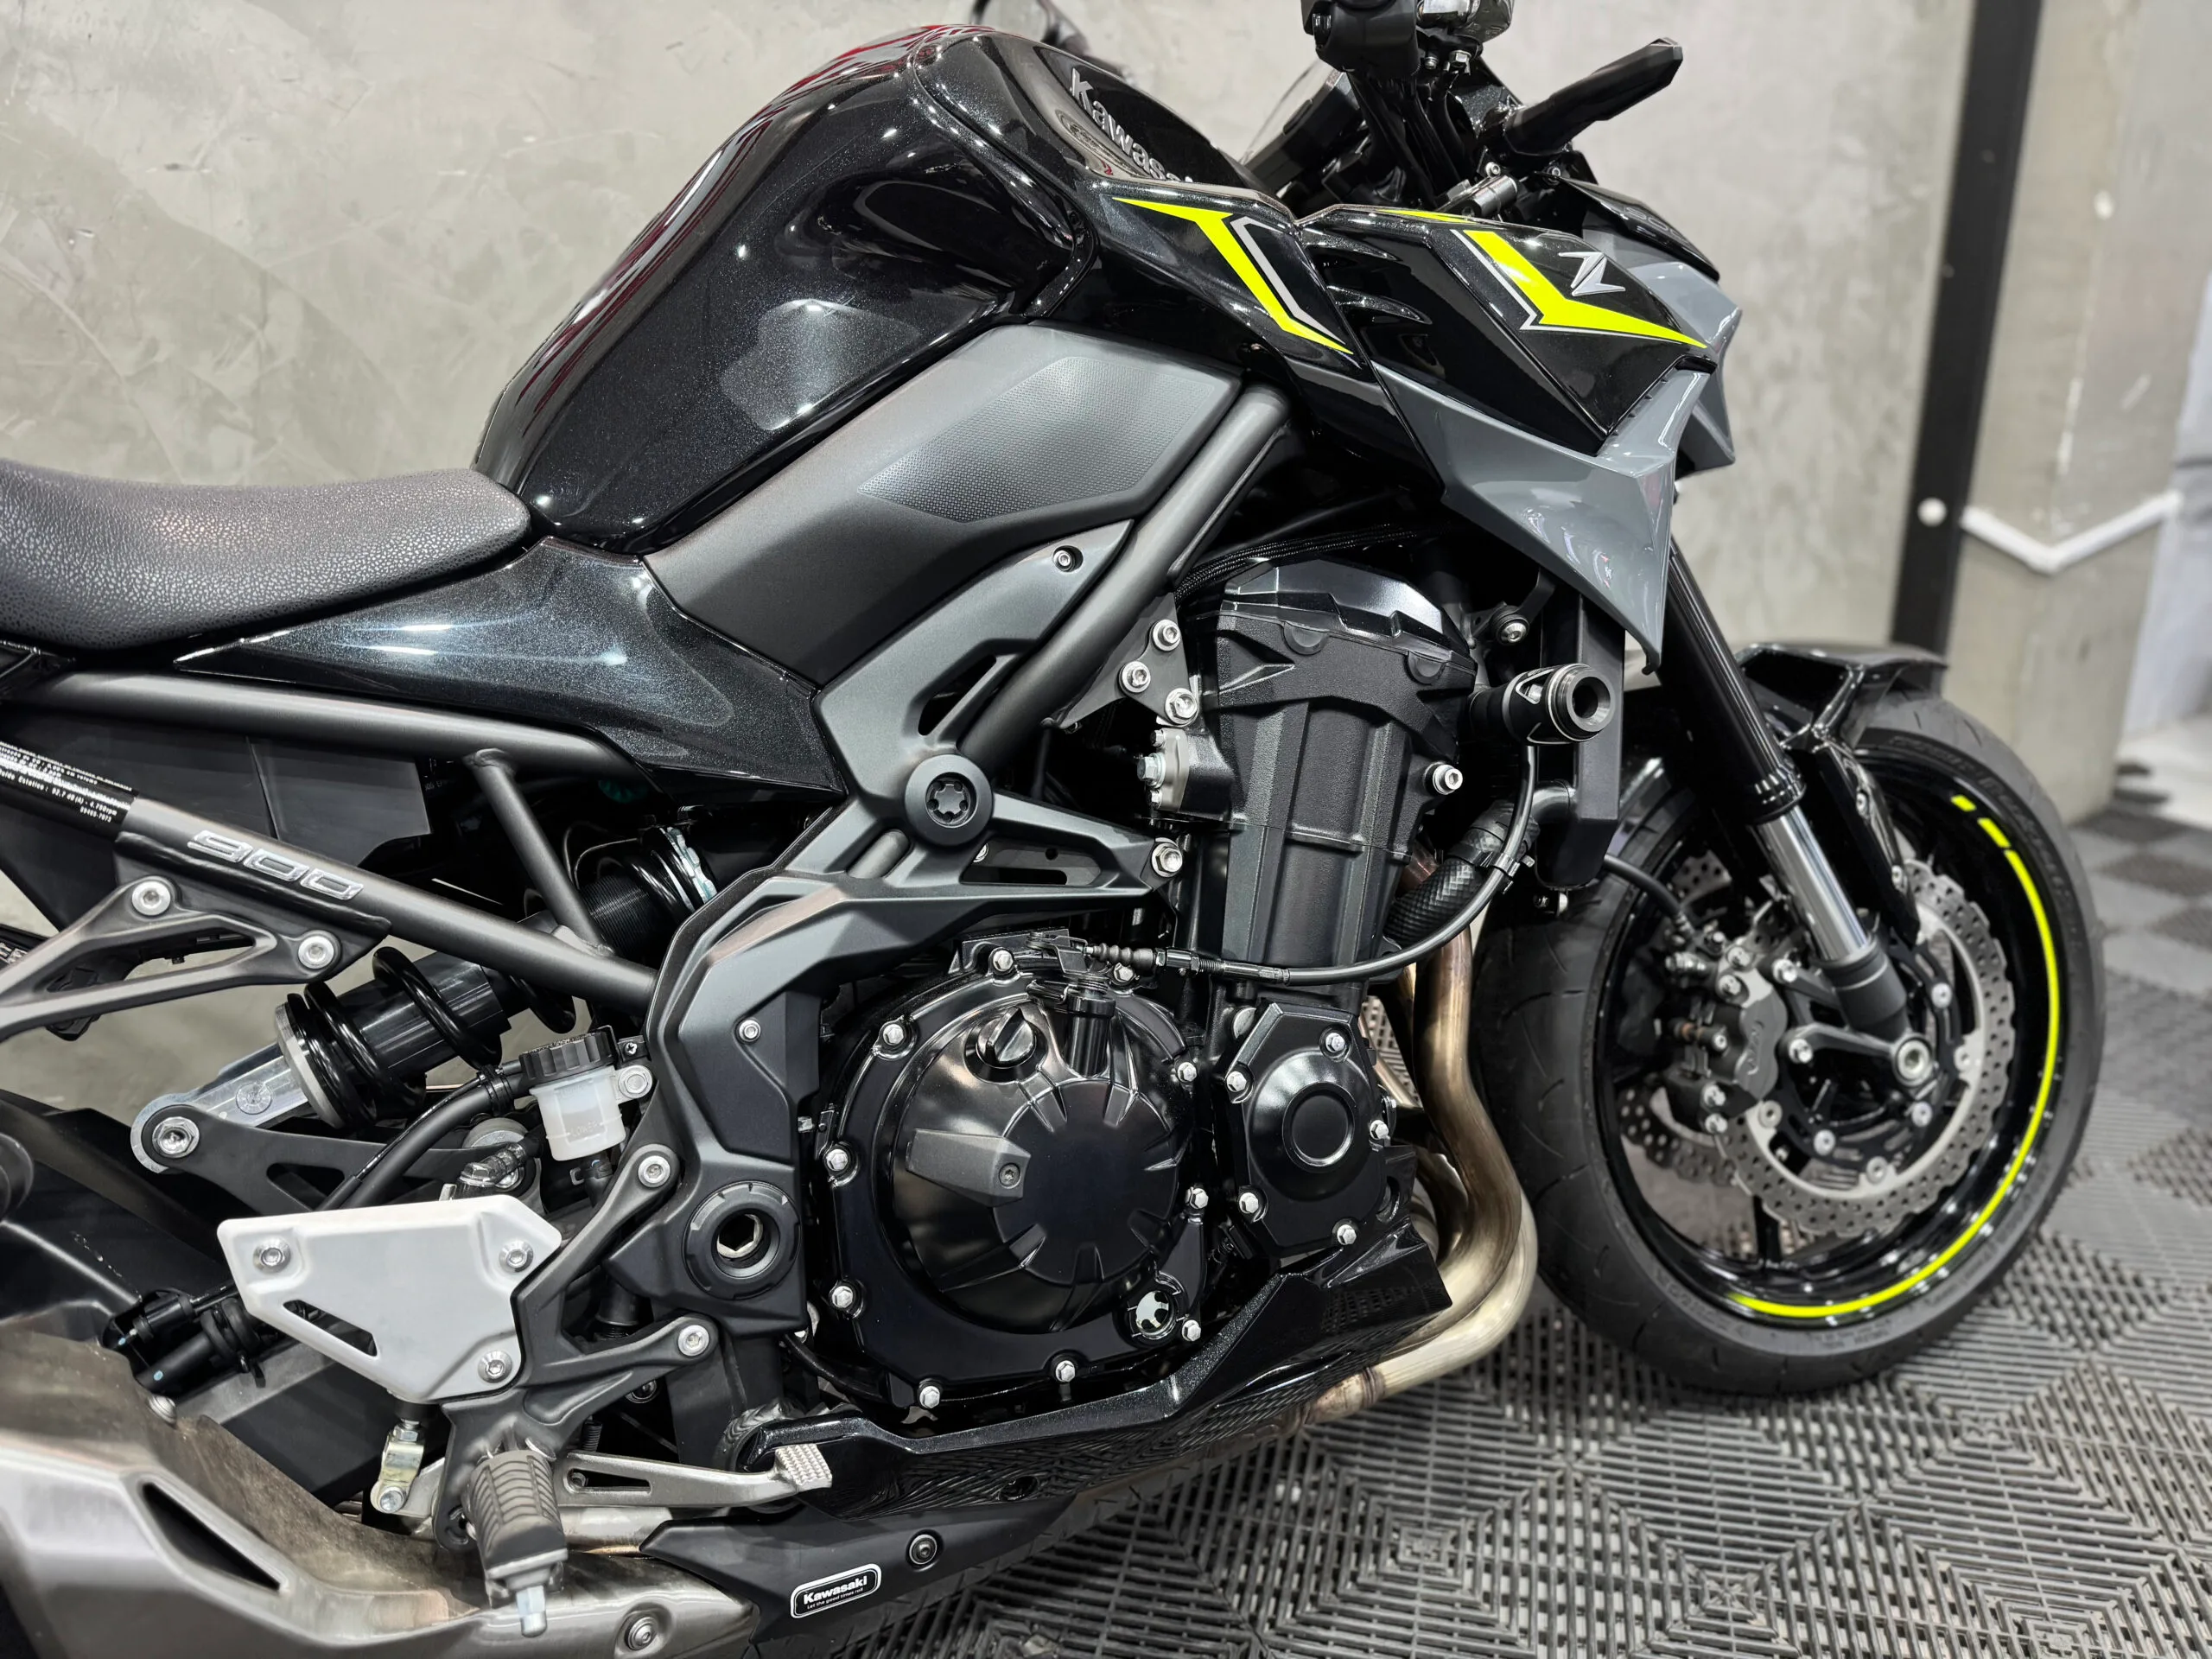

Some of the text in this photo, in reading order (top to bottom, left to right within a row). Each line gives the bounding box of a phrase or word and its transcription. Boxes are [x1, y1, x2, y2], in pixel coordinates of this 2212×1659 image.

[1071, 67, 1192, 183] Kawas
[187, 830, 364, 900] 900
[804, 1575, 868, 1605] Kawasaki
[826, 1594, 840, 1604] good
